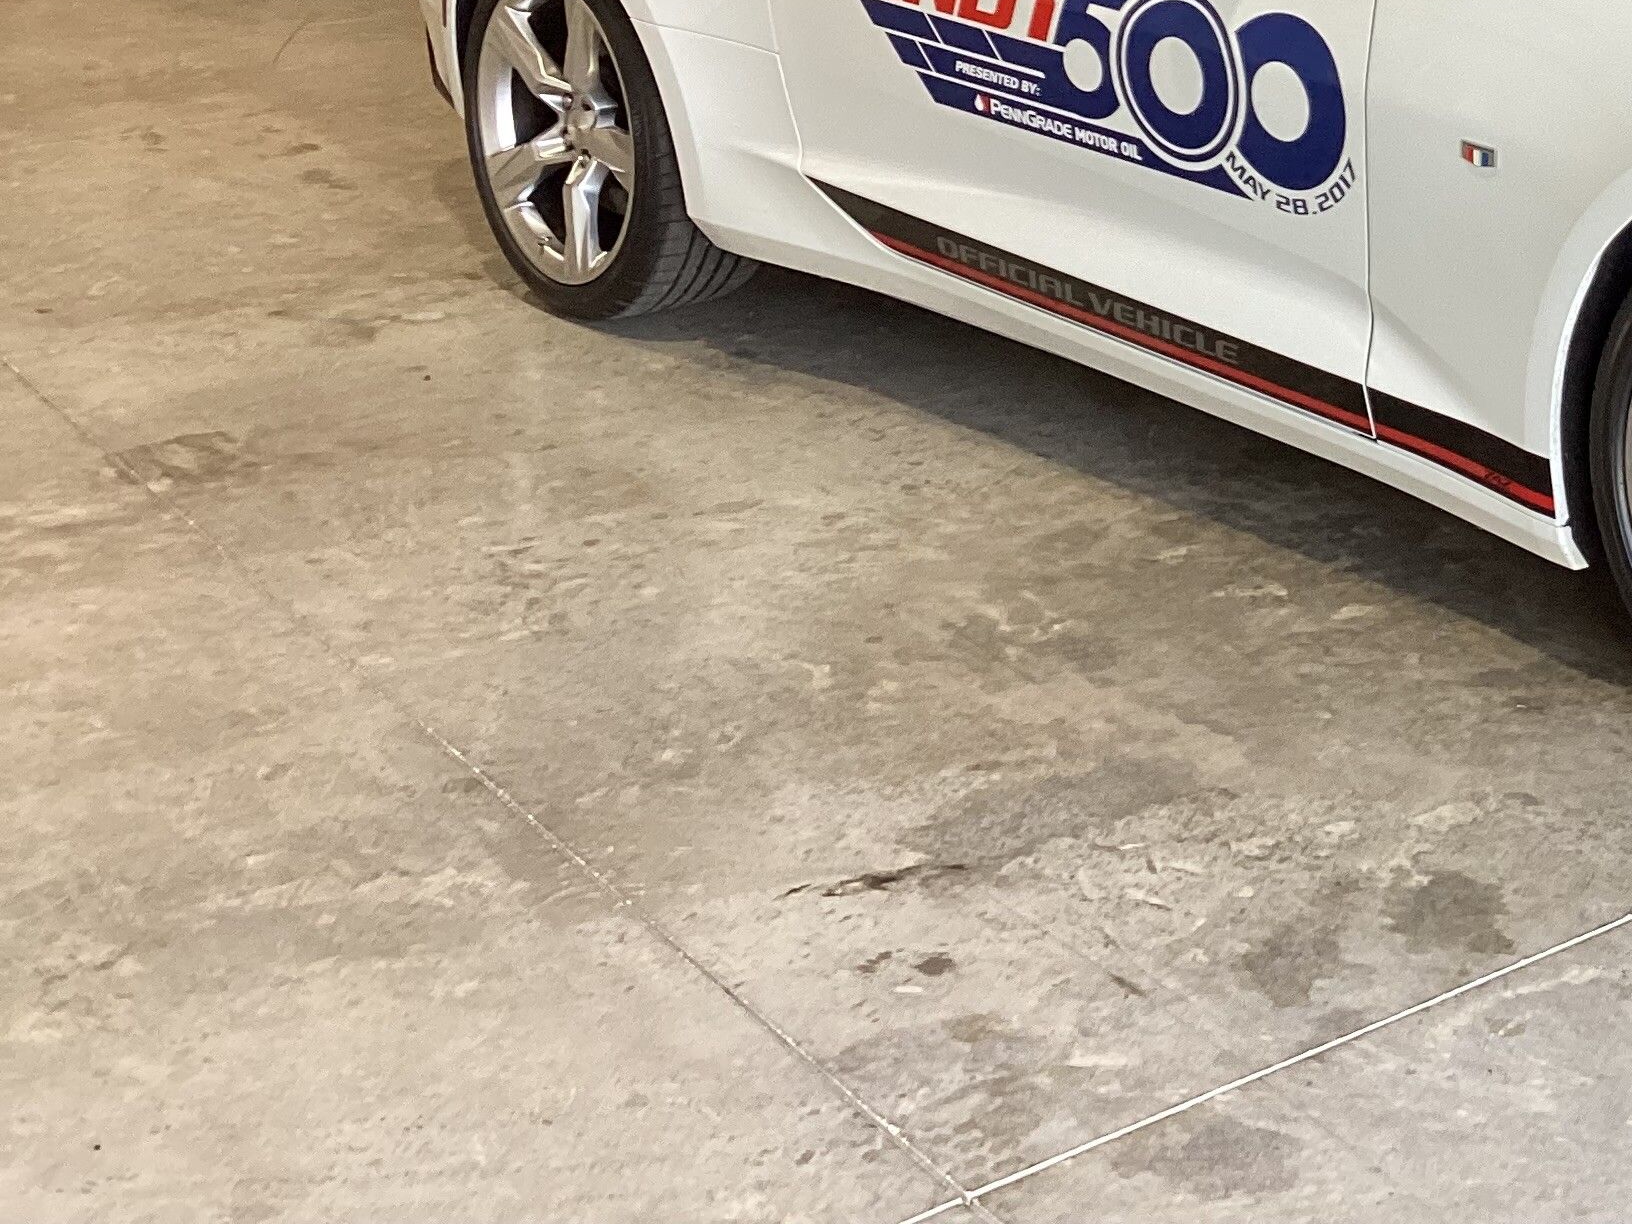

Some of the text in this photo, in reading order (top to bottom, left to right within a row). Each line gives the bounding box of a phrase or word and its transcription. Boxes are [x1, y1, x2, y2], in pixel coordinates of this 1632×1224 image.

[955, 60, 1043, 97] PRESENTED BY:
[1074, 126, 1119, 153] MOTOR
[1120, 141, 1143, 161] OIL
[1225, 149, 1271, 201] MAY
[936, 235, 1240, 364] OFFICIAL VEHICLE
